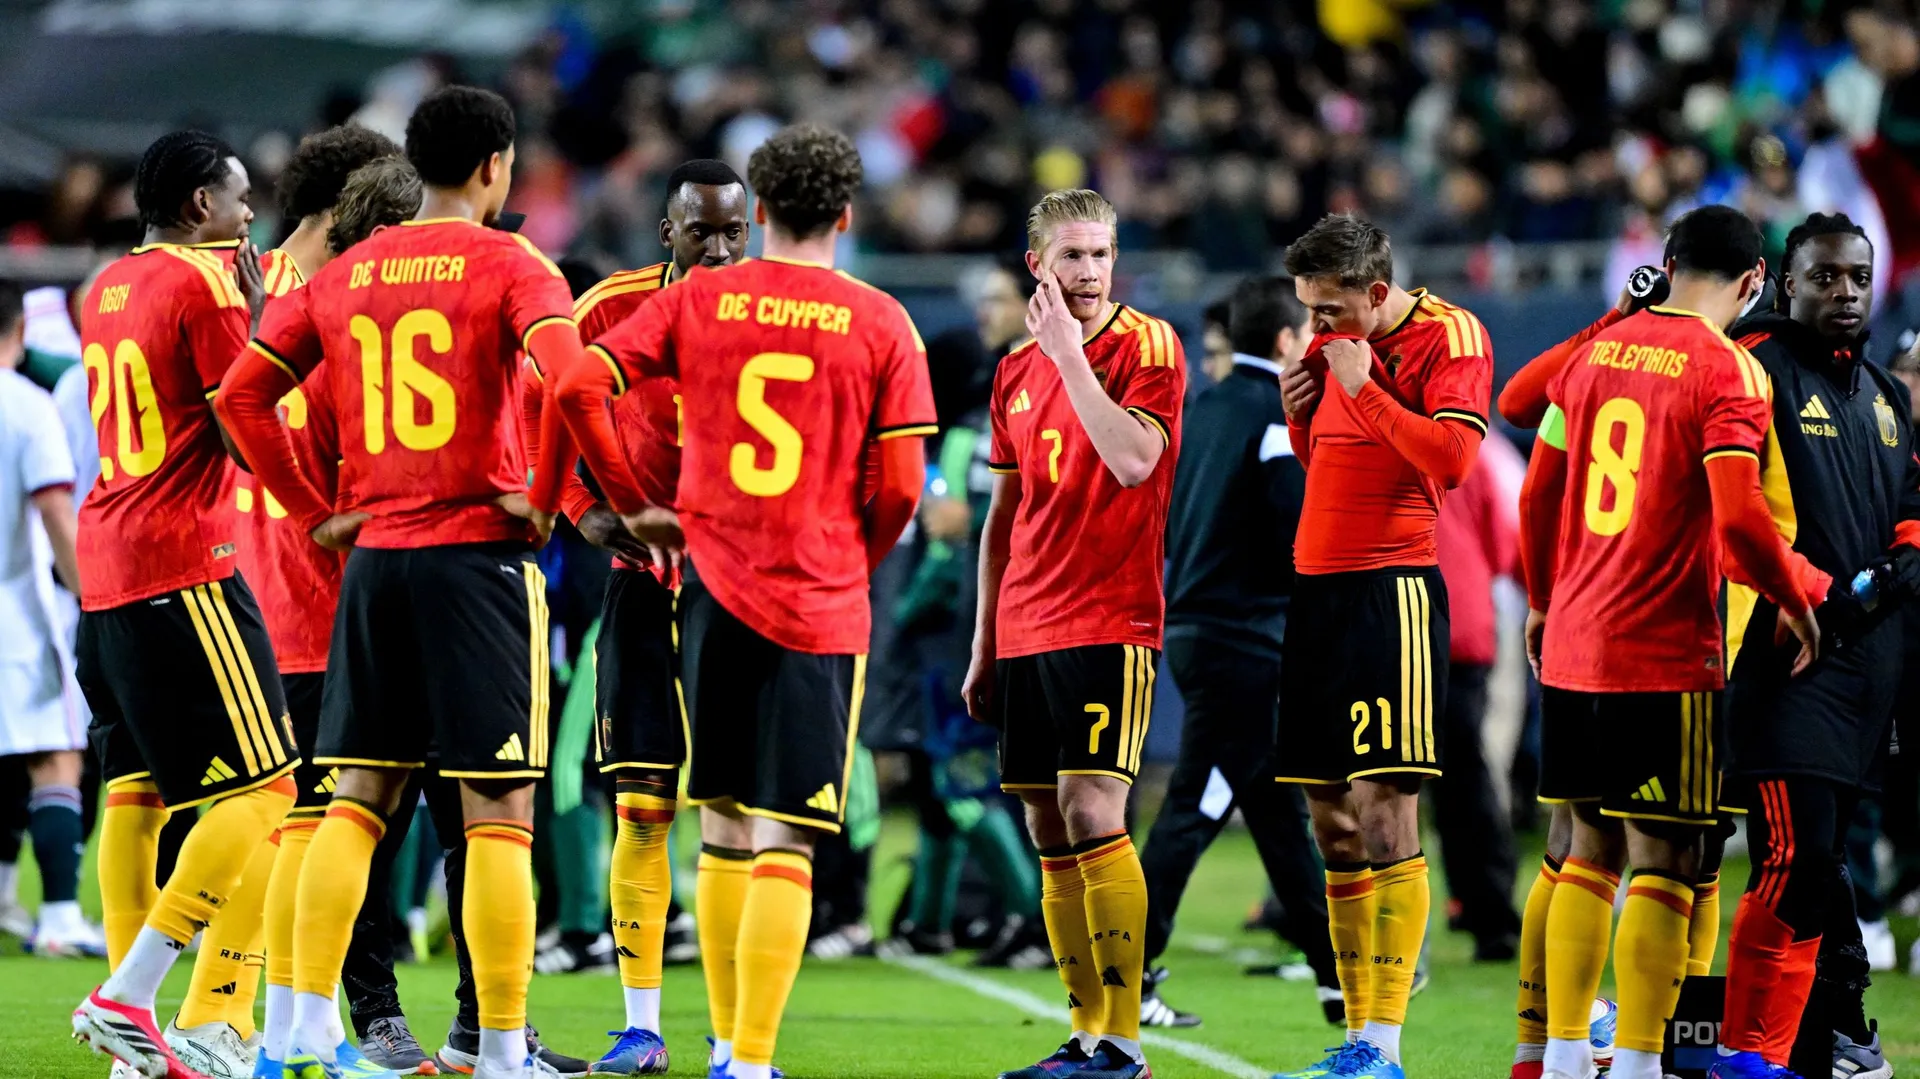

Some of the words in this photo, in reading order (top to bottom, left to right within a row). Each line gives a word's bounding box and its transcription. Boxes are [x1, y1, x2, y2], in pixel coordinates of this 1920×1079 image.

[349, 260, 375, 290] DE
[380, 255, 465, 285] WINTER
[99, 283, 131, 315] NGOY
[717, 292, 751, 321] DE
[756, 296, 852, 335] CUYPER
[350, 308, 456, 454] 16
[1588, 341, 1688, 378] TIELEMANS
[84, 338, 166, 481] 20
[729, 352, 815, 497] 5
[1801, 423, 1823, 436] ING
[1041, 429, 1062, 483] 7
[1584, 397, 1645, 536] 8
[1084, 703, 1110, 755] 7
[1350, 697, 1392, 755] 21
[1371, 955, 1403, 965] BFA
